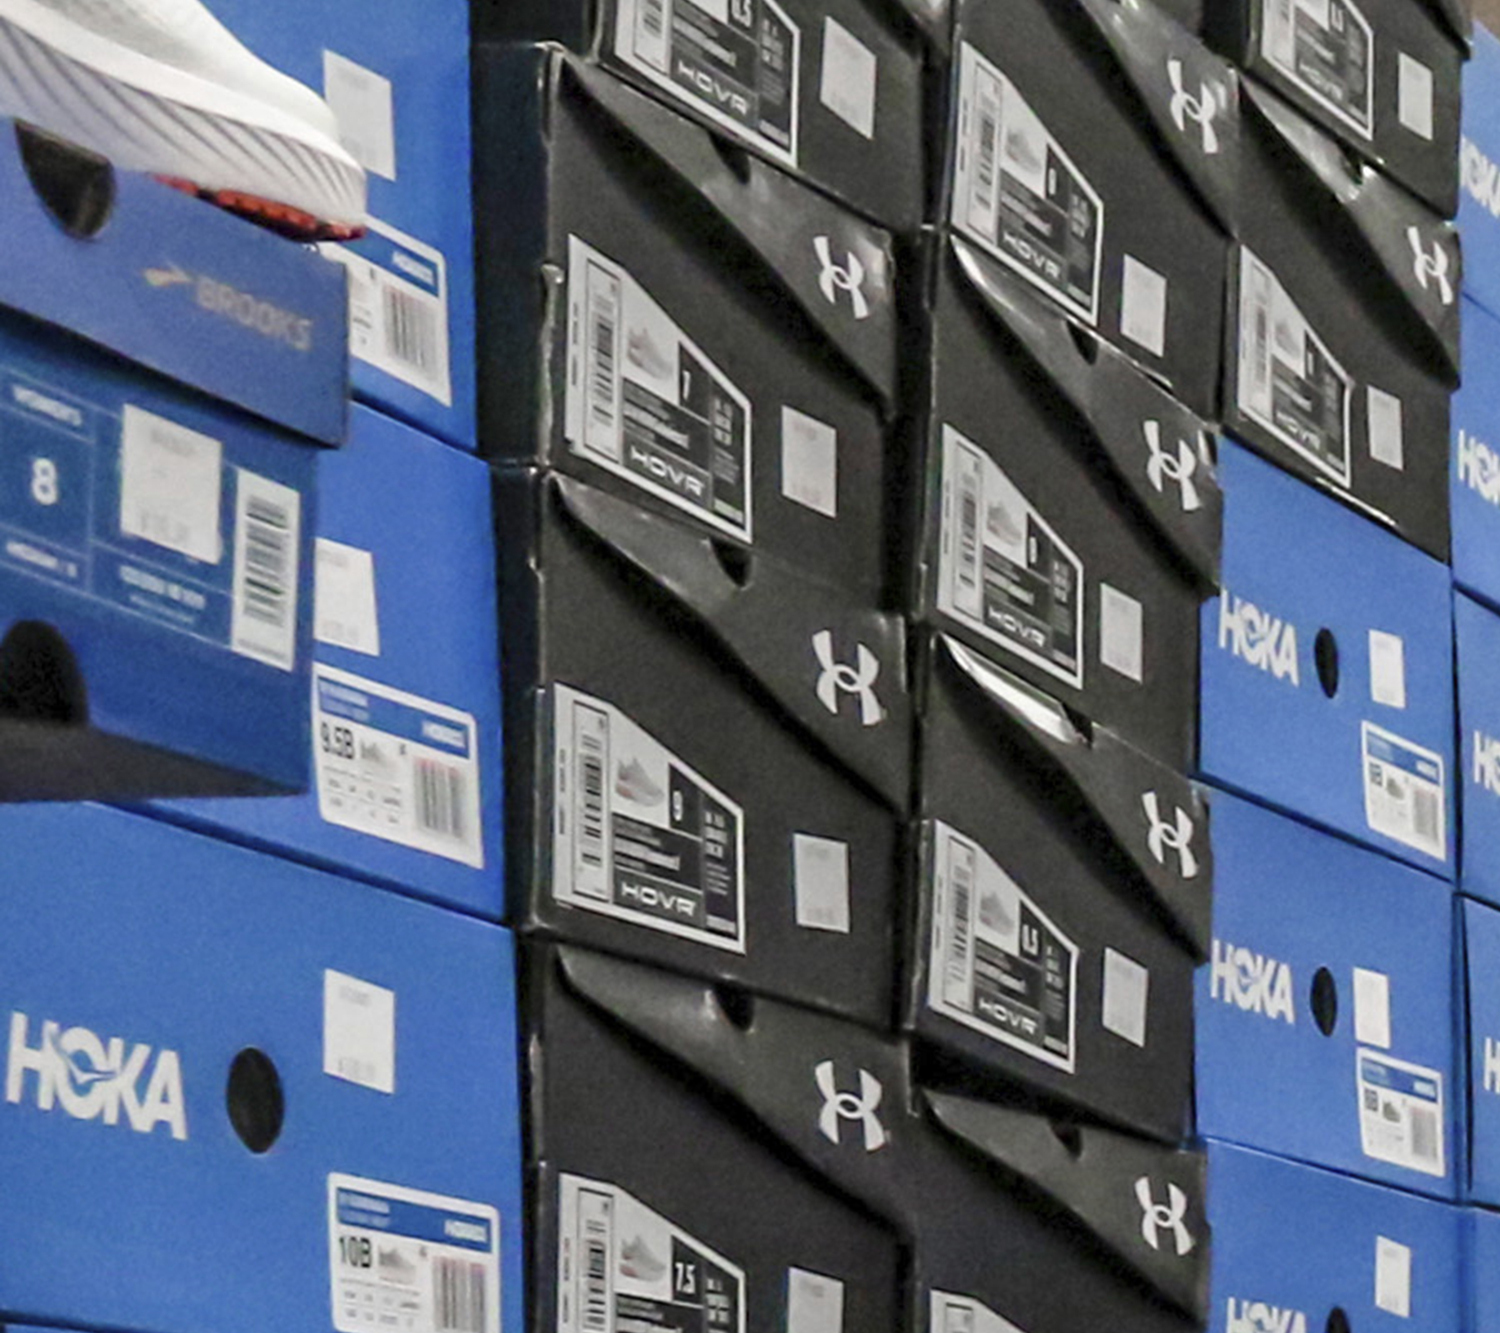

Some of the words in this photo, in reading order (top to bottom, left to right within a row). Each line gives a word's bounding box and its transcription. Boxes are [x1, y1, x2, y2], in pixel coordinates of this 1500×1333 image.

[679, 60, 748, 115] HOVR
[199, 271, 312, 351] BROOKS
[31, 456, 58, 504] 8
[629, 446, 706, 497] HOVR
[987, 606, 1047, 649] HOVR
[1219, 588, 1299, 686] HOKA
[620, 880, 697, 918] HOVR
[1211, 939, 1294, 1023] HOKA
[978, 996, 1039, 1037] HOVR
[7, 1012, 188, 1140] HOKA
[338, 1236, 374, 1268] 10B
